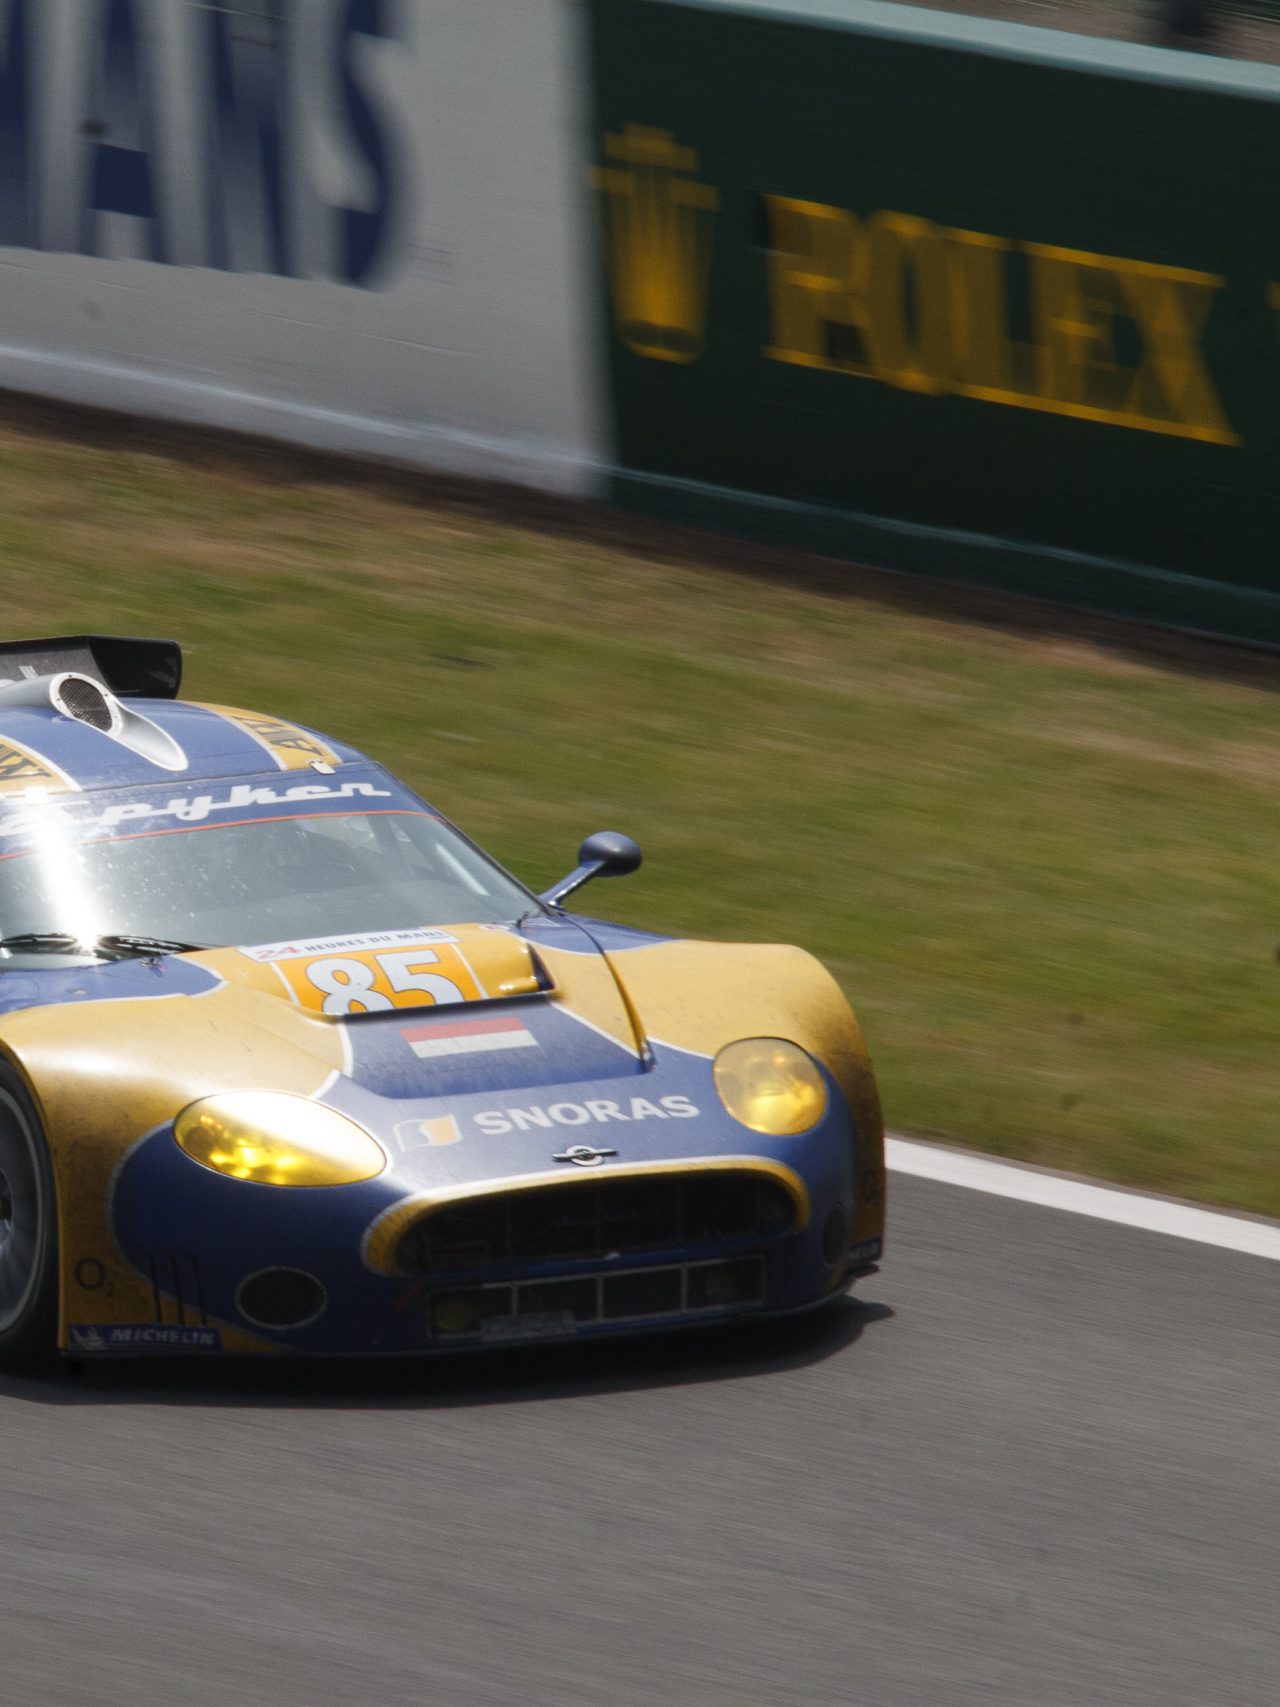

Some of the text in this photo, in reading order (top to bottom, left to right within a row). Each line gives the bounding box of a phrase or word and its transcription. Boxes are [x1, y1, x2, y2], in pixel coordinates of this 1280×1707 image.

[762, 194, 1244, 447] ROLEX
[255, 945, 302, 960] 24
[304, 938, 366, 952] HEURES
[368, 934, 392, 944] DU
[397, 930, 444, 941] MANS
[304, 948, 465, 1015] 85
[473, 1096, 701, 1135] SNORAS
[110, 1328, 214, 1346] MICHELIN
